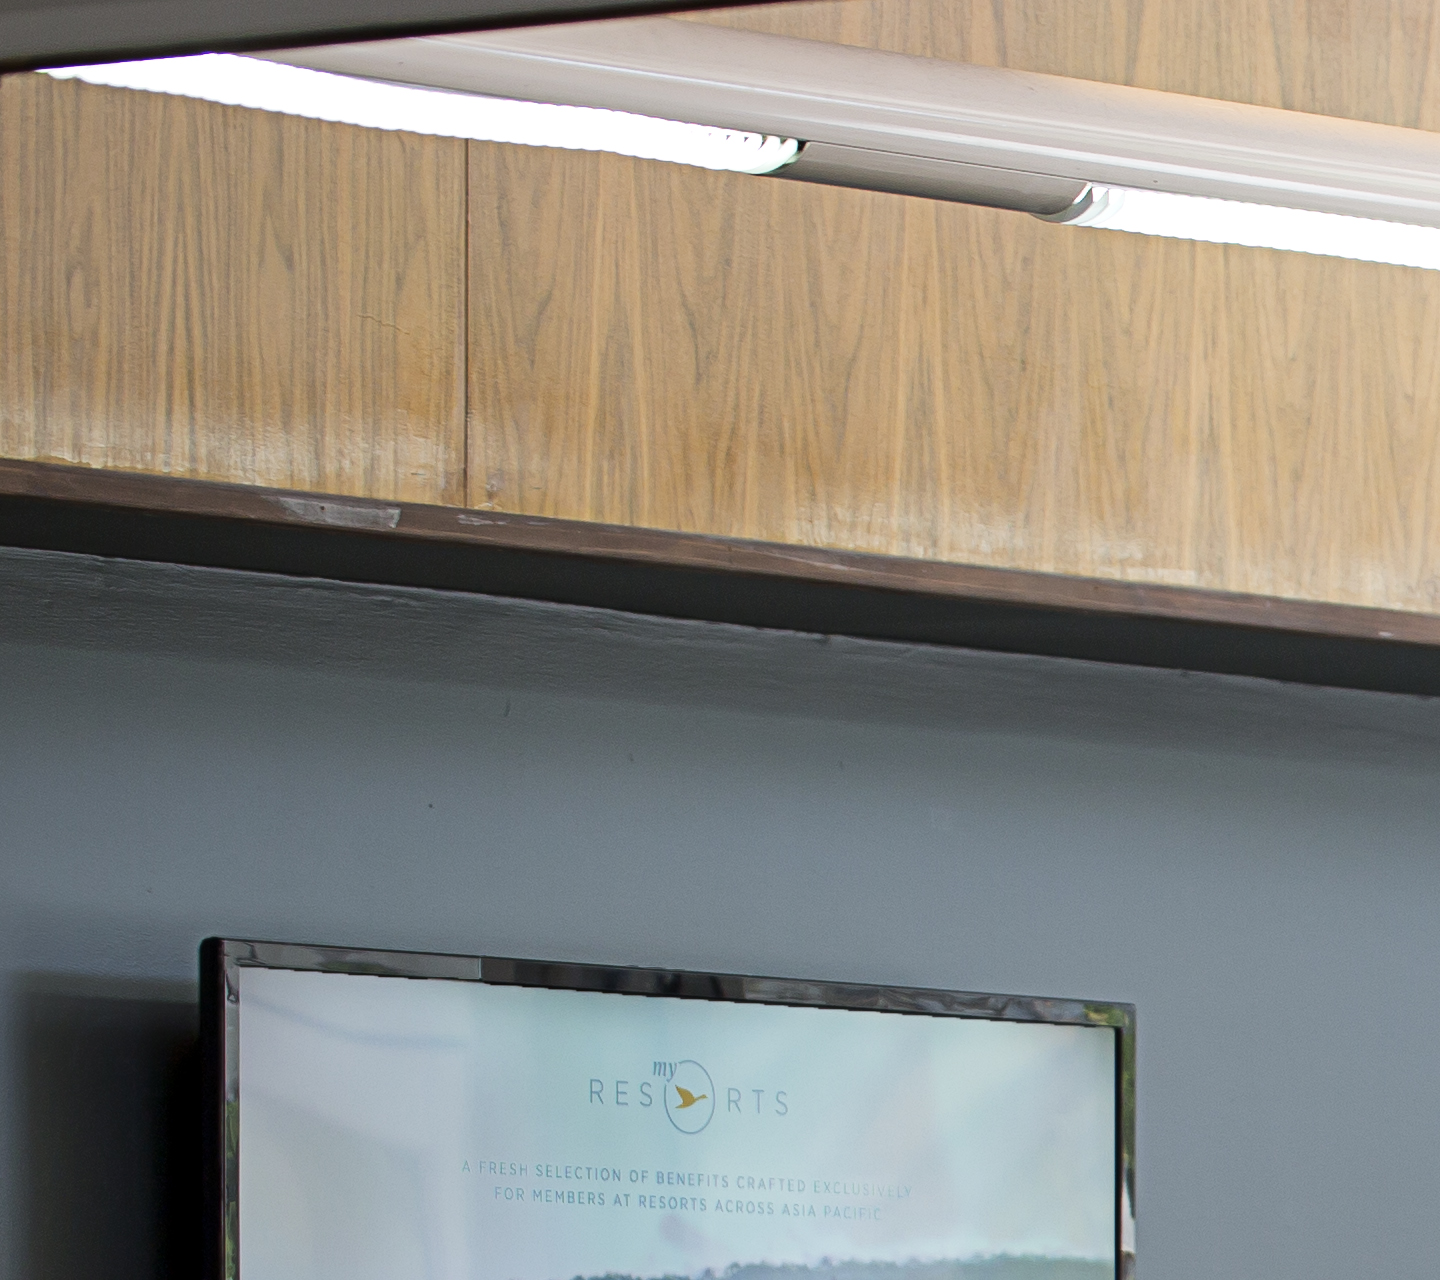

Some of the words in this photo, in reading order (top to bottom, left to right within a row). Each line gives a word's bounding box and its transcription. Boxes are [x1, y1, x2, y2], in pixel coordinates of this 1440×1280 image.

[462, 1160, 471, 1173] A
[479, 1161, 528, 1177] FRESH
[535, 1164, 622, 1182] SELECTION
[629, 1170, 649, 1183] OF
[656, 1171, 729, 1188] BENEFITS
[736, 1176, 806, 1192] CRAFTED
[813, 1180, 912, 1198] EXCLUSIVELY
[494, 1186, 525, 1201] FOR
[533, 1189, 605, 1206] MEMBERS
[613, 1194, 630, 1207] AT
[638, 1195, 707, 1212] RESORTS
[715, 1199, 774, 1215] ACROSS
[781, 1204, 816, 1217] ASIA
[824, 1206, 881, 1221] PACIFIC
